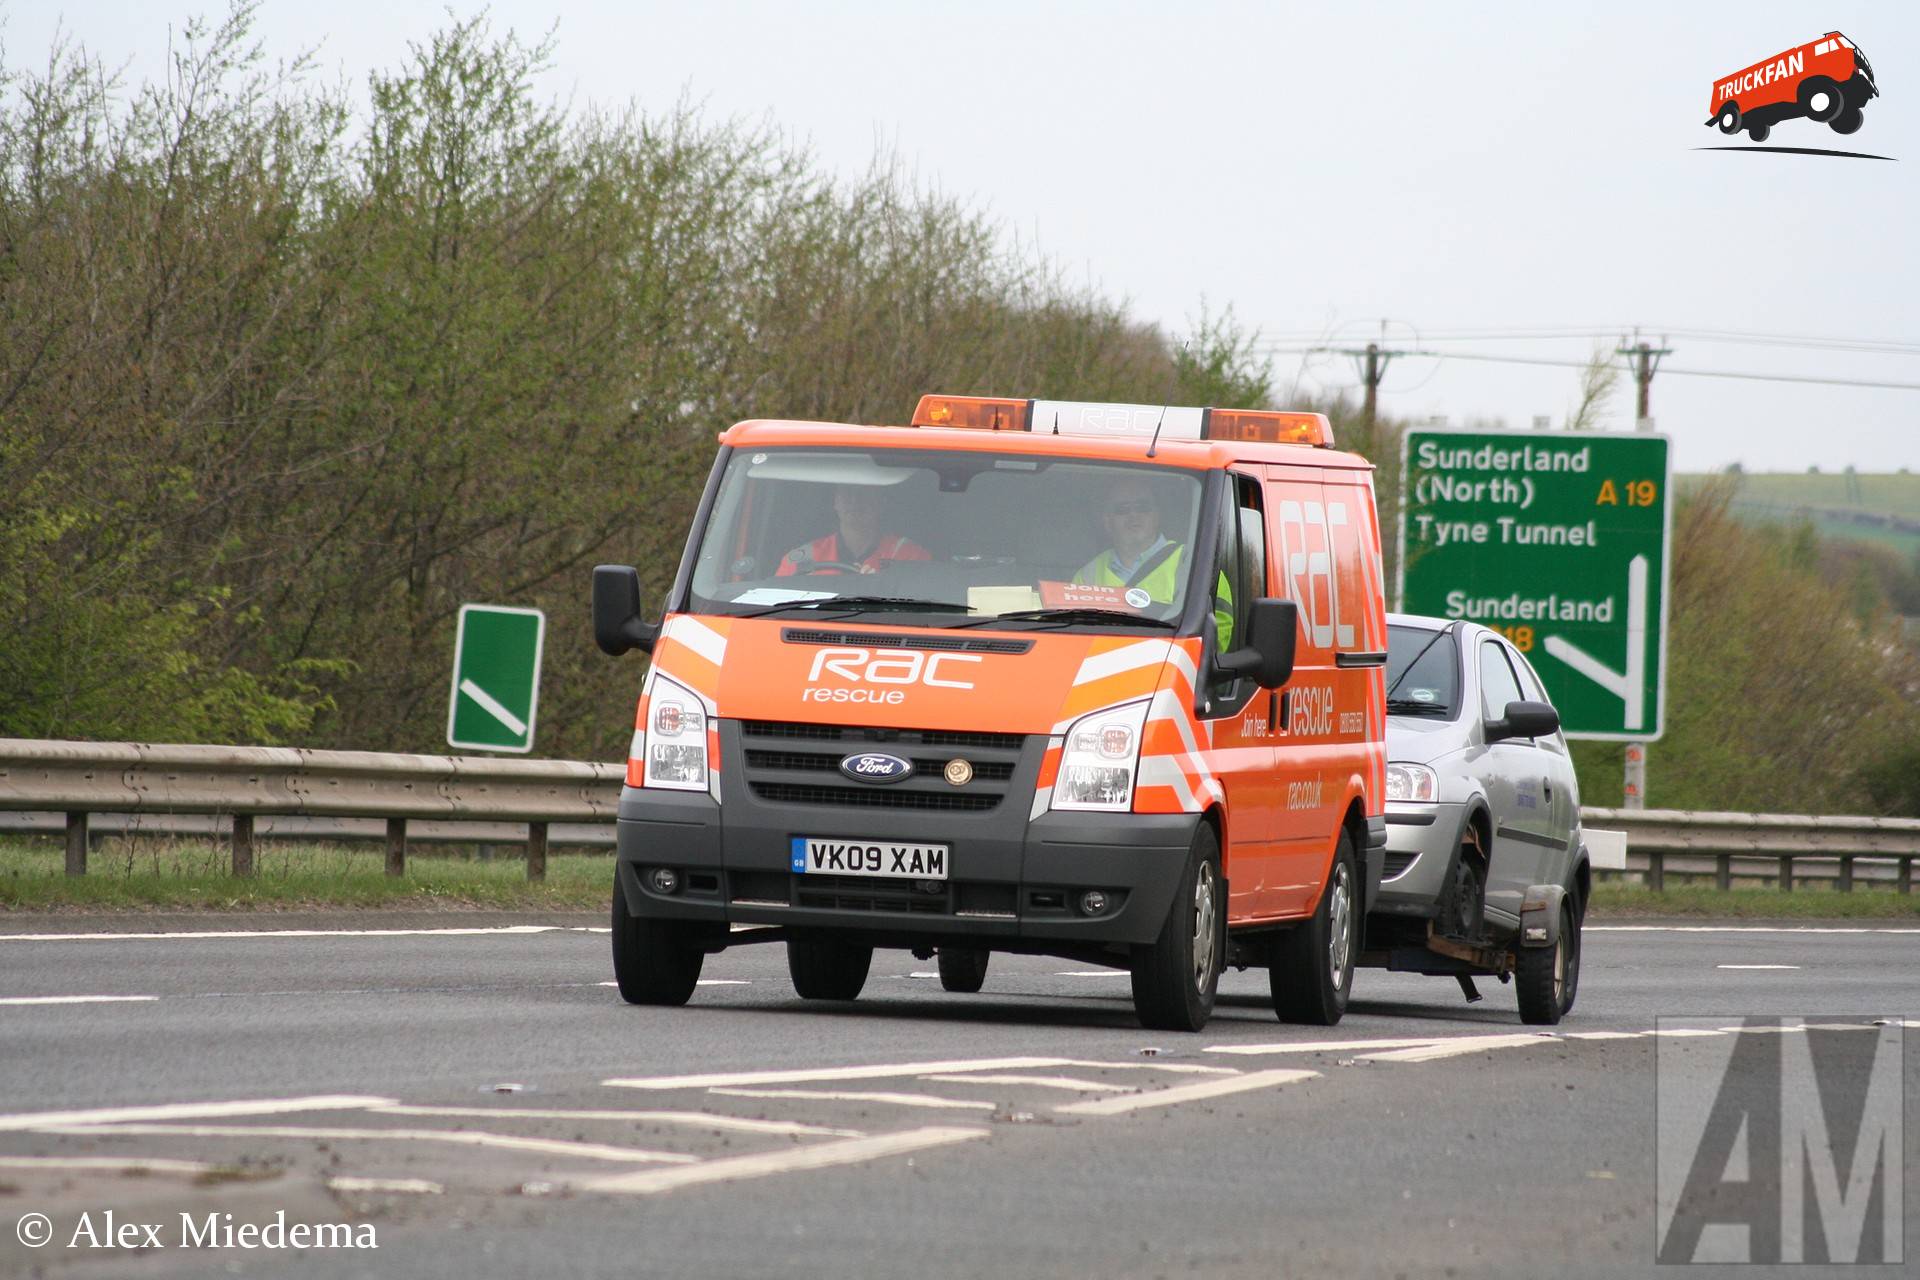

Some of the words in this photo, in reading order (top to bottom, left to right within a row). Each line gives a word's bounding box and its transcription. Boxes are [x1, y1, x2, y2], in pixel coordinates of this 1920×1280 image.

[1418, 442, 1590, 472] Sunderland
[1416, 476, 1534, 509] (North)
[1596, 480, 1617, 505] A
[1626, 480, 1657, 506] 19
[1416, 515, 1488, 546] Tyne
[1497, 517, 1597, 546] Tunnel
[1063, 583, 1115, 593] Join
[1446, 591, 1614, 622] Sunderland
[802, 687, 905, 705] rescue
[1287, 686, 1334, 736] rescue
[856, 757, 893, 774] Ford
[811, 843, 882, 872] VK09
[890, 847, 944, 875] XAM
